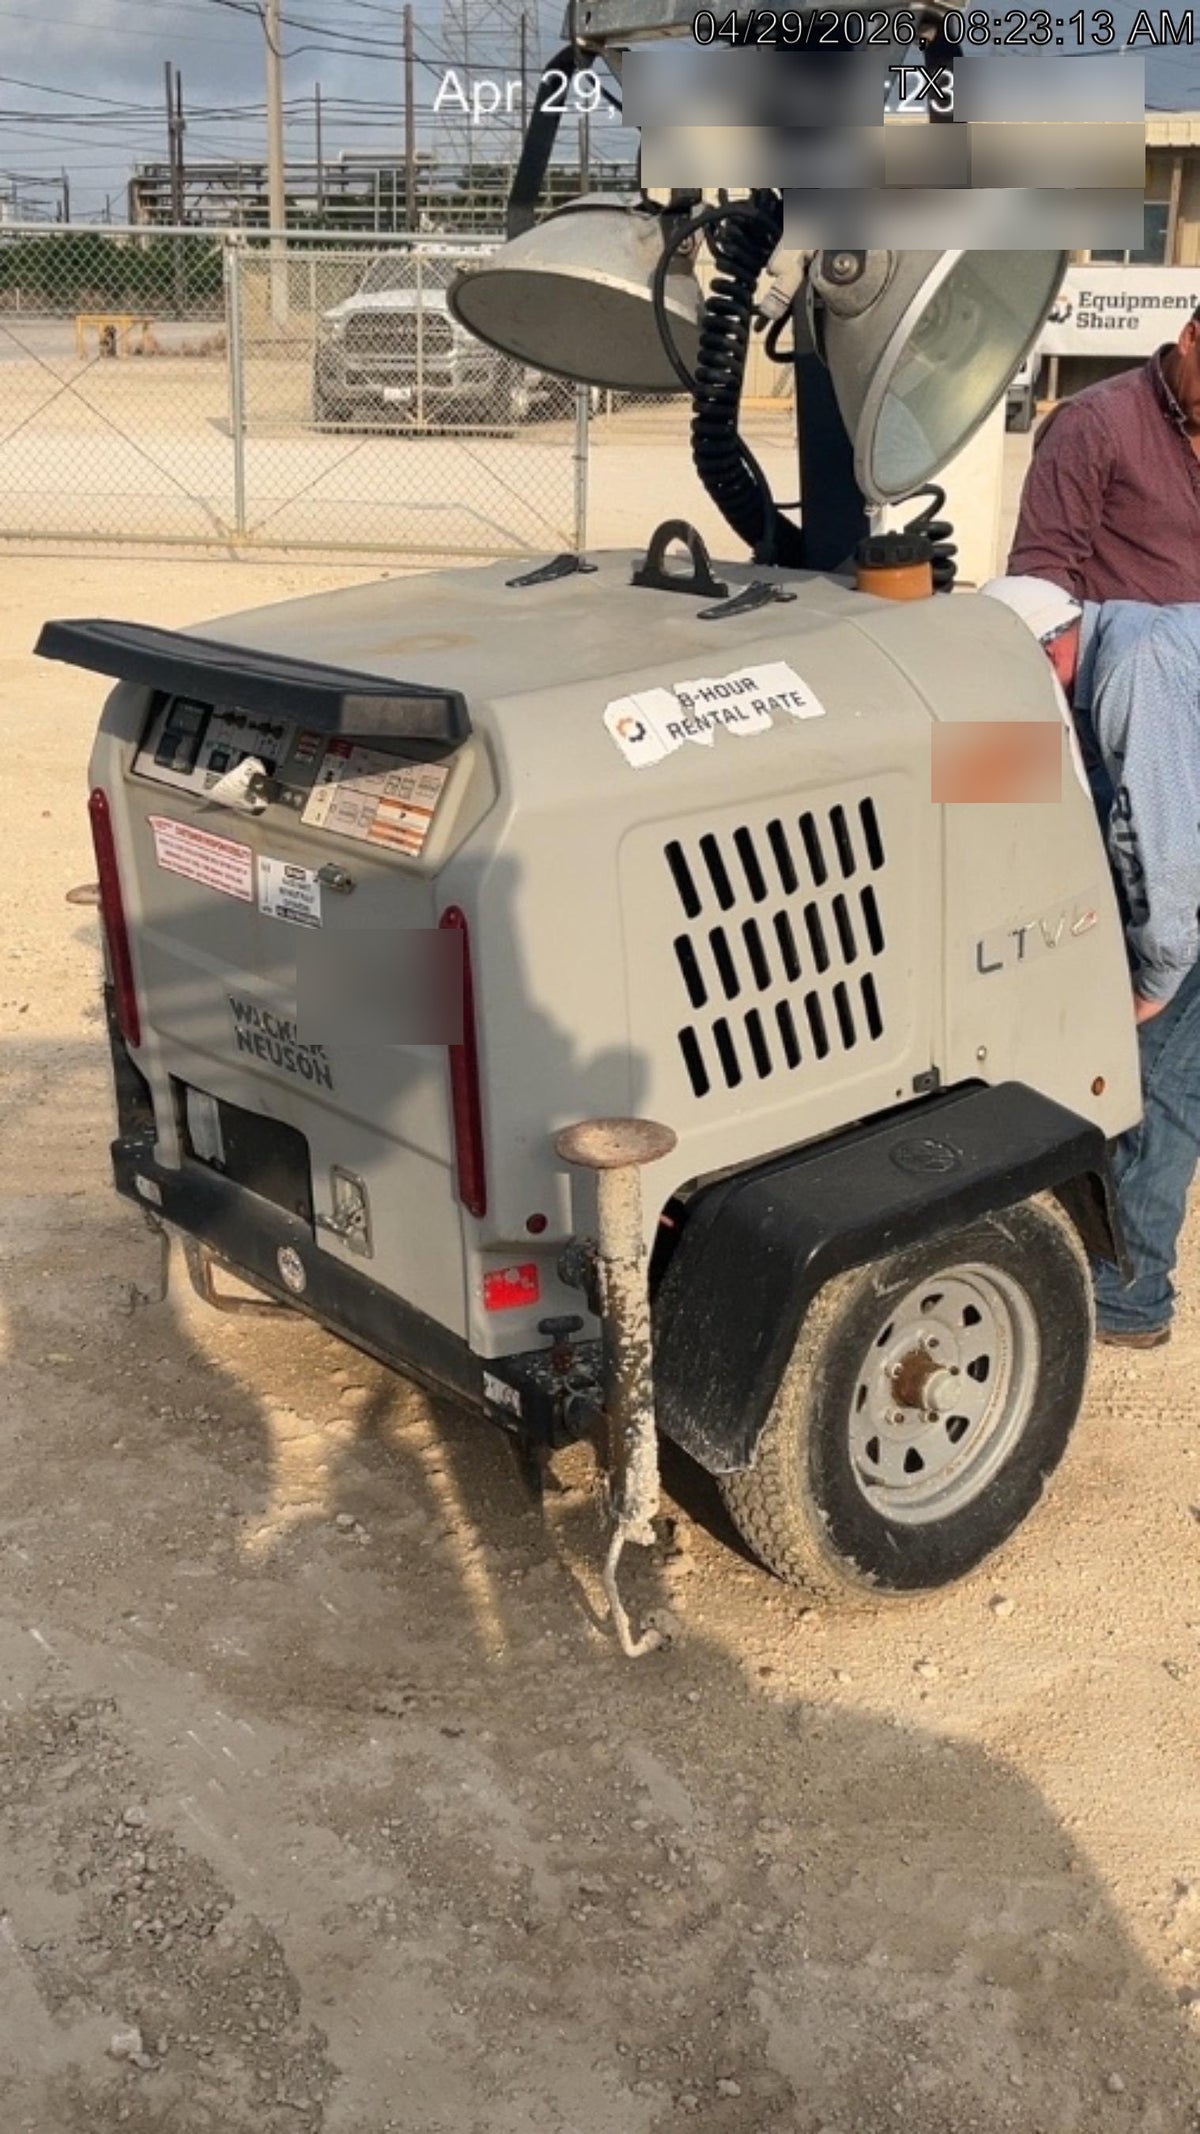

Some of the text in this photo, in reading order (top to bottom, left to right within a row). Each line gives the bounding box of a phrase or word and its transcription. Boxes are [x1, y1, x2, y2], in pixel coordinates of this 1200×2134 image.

[1078, 291, 1199, 312] Equipment
[1076, 312, 1139, 330] Share
[666, 690, 806, 740] RENTAL RATE
[234, 1025, 334, 1091] NEUSON
